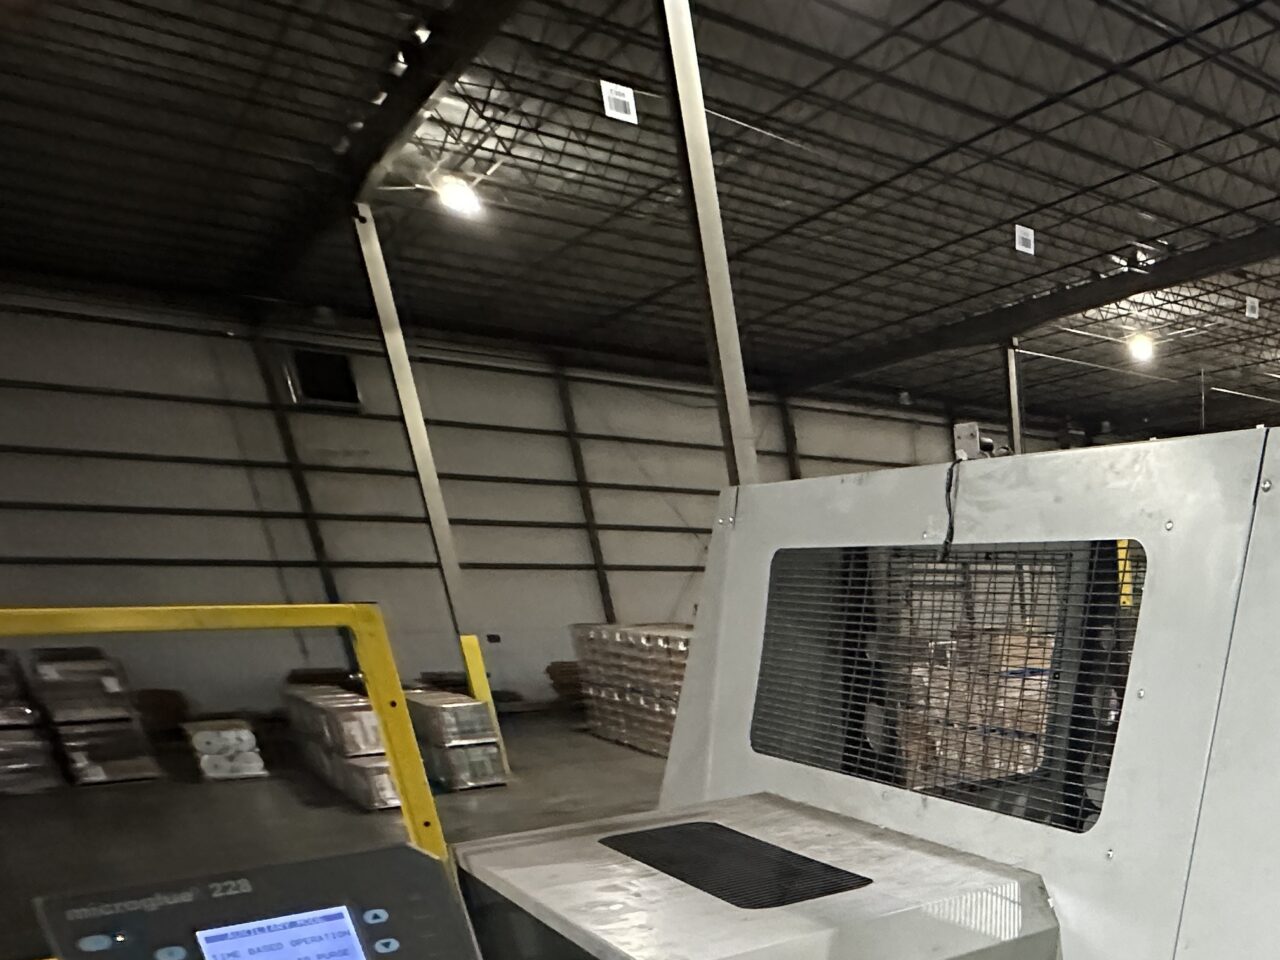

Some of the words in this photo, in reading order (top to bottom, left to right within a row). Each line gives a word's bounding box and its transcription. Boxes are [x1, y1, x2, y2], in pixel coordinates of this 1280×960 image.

[208, 878, 253, 899] 228
[247, 941, 285, 956] BASED
[289, 929, 352, 948] OPERATION
